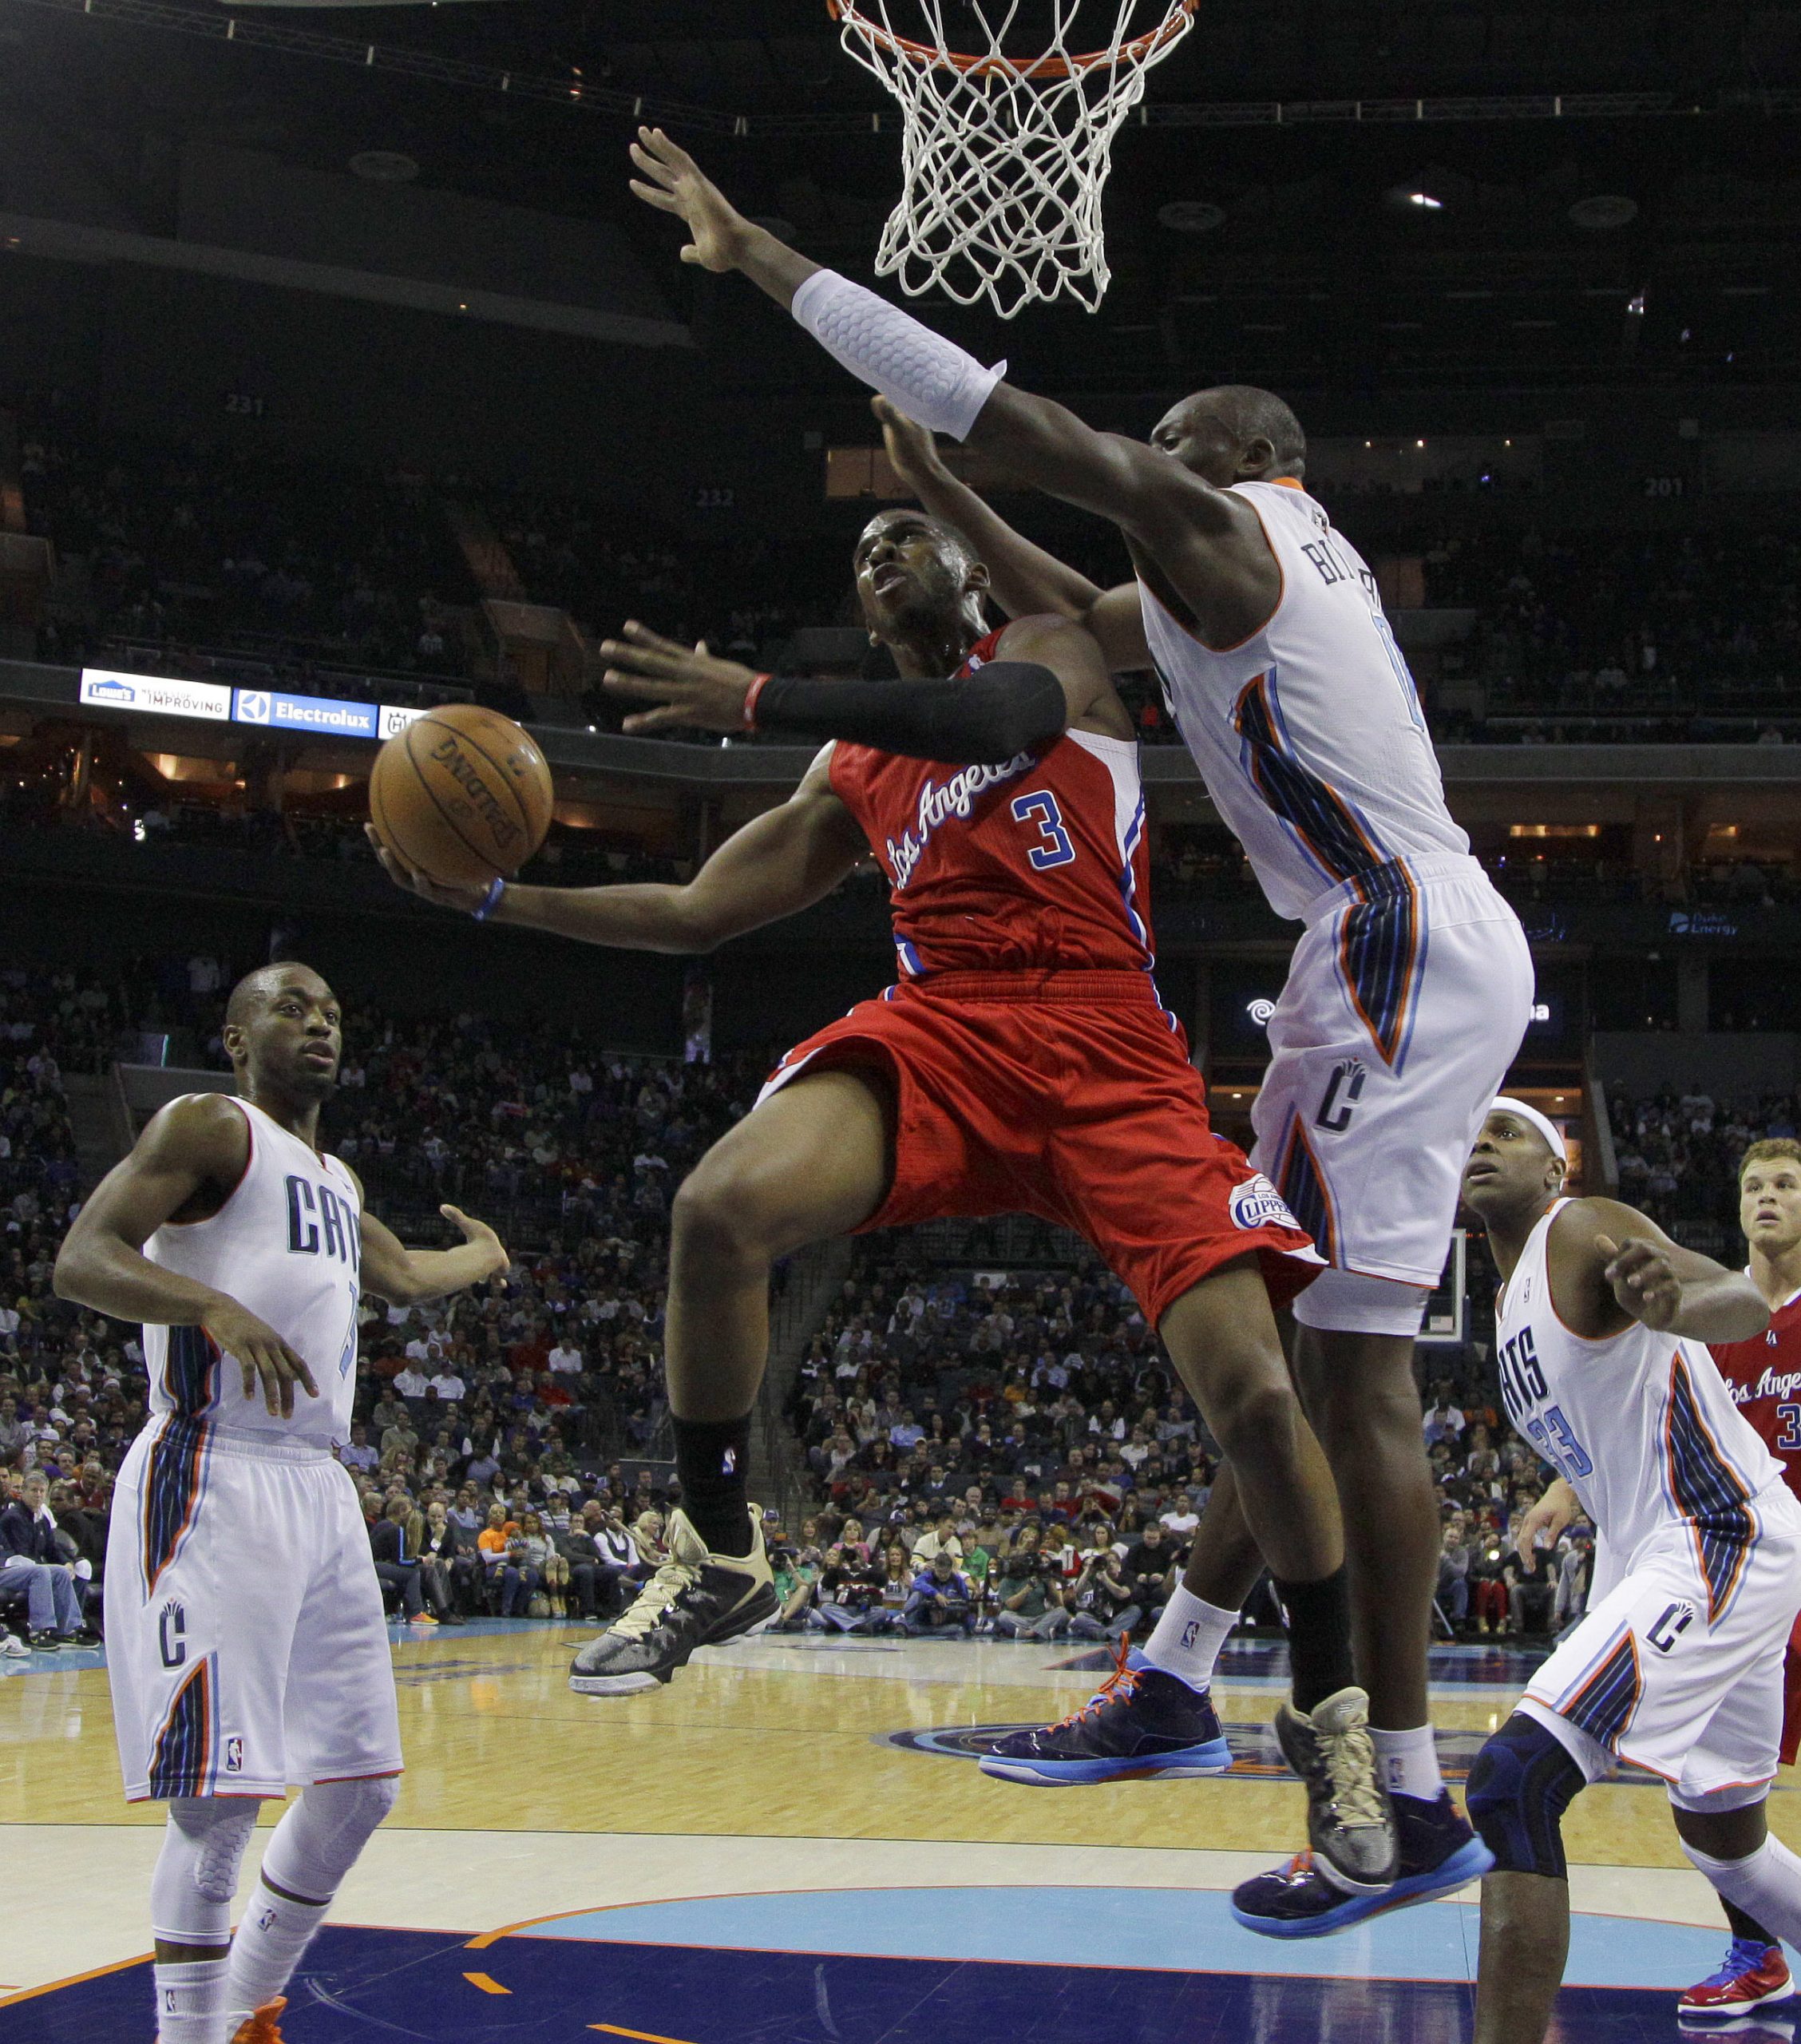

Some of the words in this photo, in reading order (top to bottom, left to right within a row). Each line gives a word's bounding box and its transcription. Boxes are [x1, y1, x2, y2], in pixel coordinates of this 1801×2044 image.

[226, 394, 262, 415] 231
[696, 487, 733, 507] 232
[1645, 477, 1682, 496] 201
[148, 693, 223, 713] IMPROVING
[276, 702, 370, 728] Electrolux
[1010, 790, 1075, 871] 3
[886, 831, 920, 890] Los
[1691, 924, 1738, 937] Energy
[284, 1175, 361, 1274] CAT
[1498, 1325, 1550, 1421] ATS
